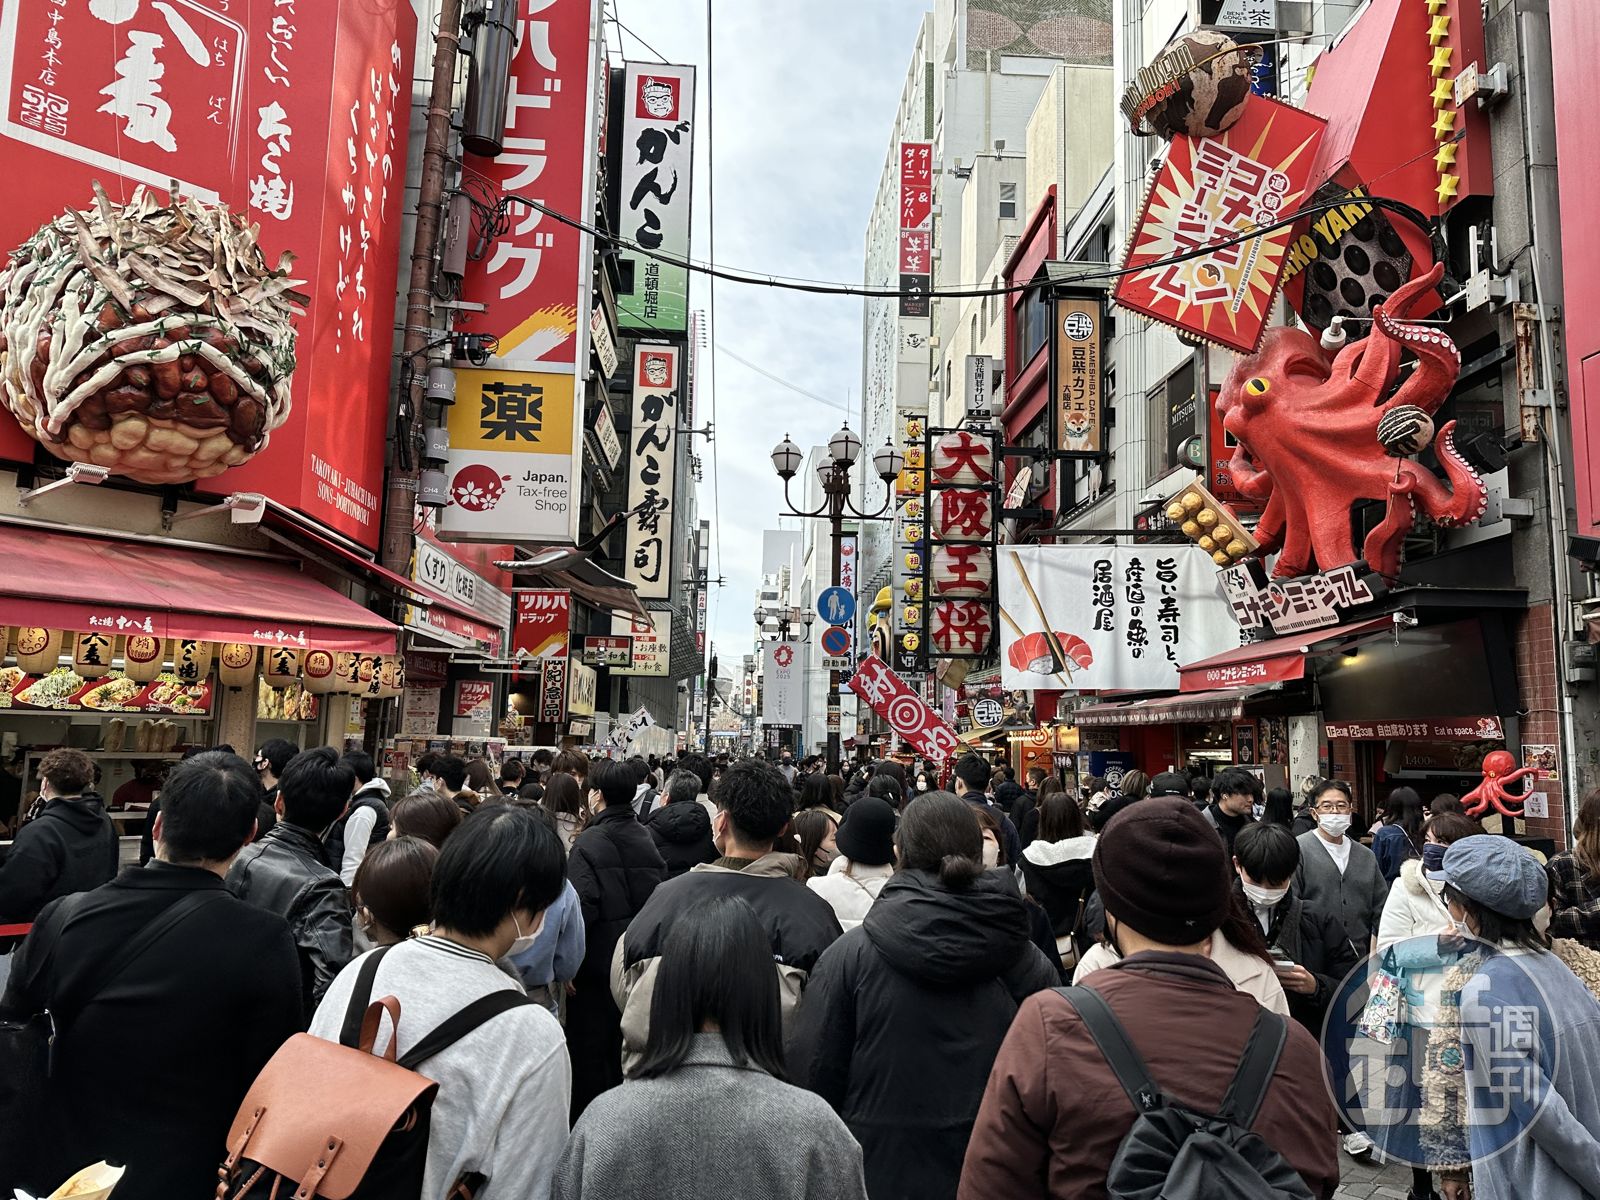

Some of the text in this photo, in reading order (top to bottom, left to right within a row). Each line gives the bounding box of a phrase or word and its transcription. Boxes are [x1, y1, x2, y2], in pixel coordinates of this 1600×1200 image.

[1248, 9, 1271, 26] 茶
[1138, 44, 1195, 101] MUSEUM
[250, 101, 293, 220] たこ焼
[630, 120, 690, 250] がんこ
[904, 148, 915, 229] ダイニングバー
[901, 231, 910, 239] 8F
[643, 262, 660, 319] 道頓堀店
[1072, 346, 1086, 411] 豆柴カフェ
[480, 381, 544, 442] 薬
[1063, 384, 1072, 411] 大阪店
[522, 470, 568, 484] Japan.
[516, 485, 567, 499] Tax-free
[534, 499, 567, 514] Shop
[932, 431, 998, 654] 大阪王将
[424, 552, 446, 585] くすり
[455, 570, 474, 601] 化粧品
[1092, 559, 1115, 632] 居酒屋
[520, 594, 567, 610] ツルハ
[1125, 557, 1150, 660] 産直の魚の
[1156, 557, 1181, 674] 旨い寿司と、
[89, 615, 153, 633] たこ焼 十八番
[519, 612, 559, 624] ドラッグ
[1321, 614, 1337, 622] Museum
[80, 632, 110, 665] 八番
[273, 647, 296, 676] 八番
[822, 659, 848, 668] 自動車
[1221, 664, 1267, 681] コナモンミュージアム
[462, 682, 490, 694] ツルハ
[1377, 723, 1428, 737] 自由席あります
[1434, 726, 1446, 735] Eat
[1446, 726, 1453, 735] in
